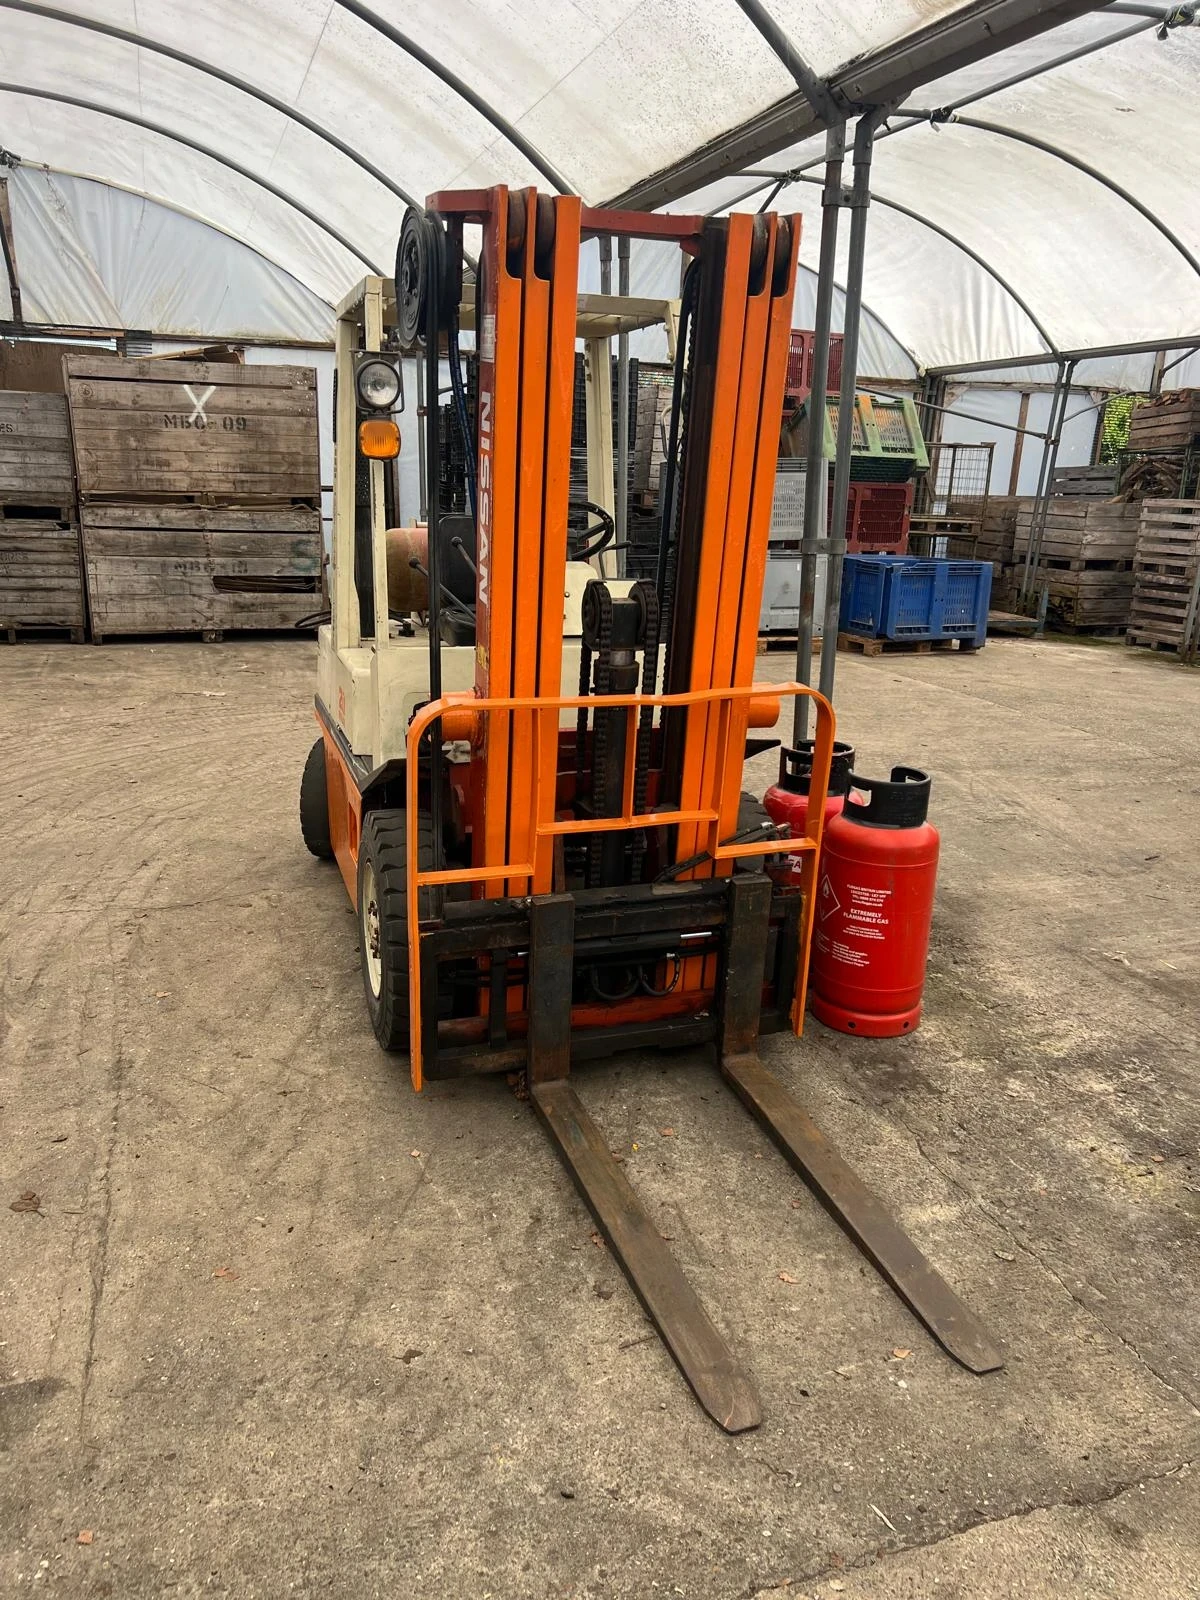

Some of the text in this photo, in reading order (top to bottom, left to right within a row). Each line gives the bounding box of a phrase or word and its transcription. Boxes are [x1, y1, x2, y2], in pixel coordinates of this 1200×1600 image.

[222, 416, 247, 432] 09
[478, 391, 491, 609] NISSAN
[843, 911, 876, 924] FLAMMABLE
[850, 908, 882, 918] EXTREMELY
